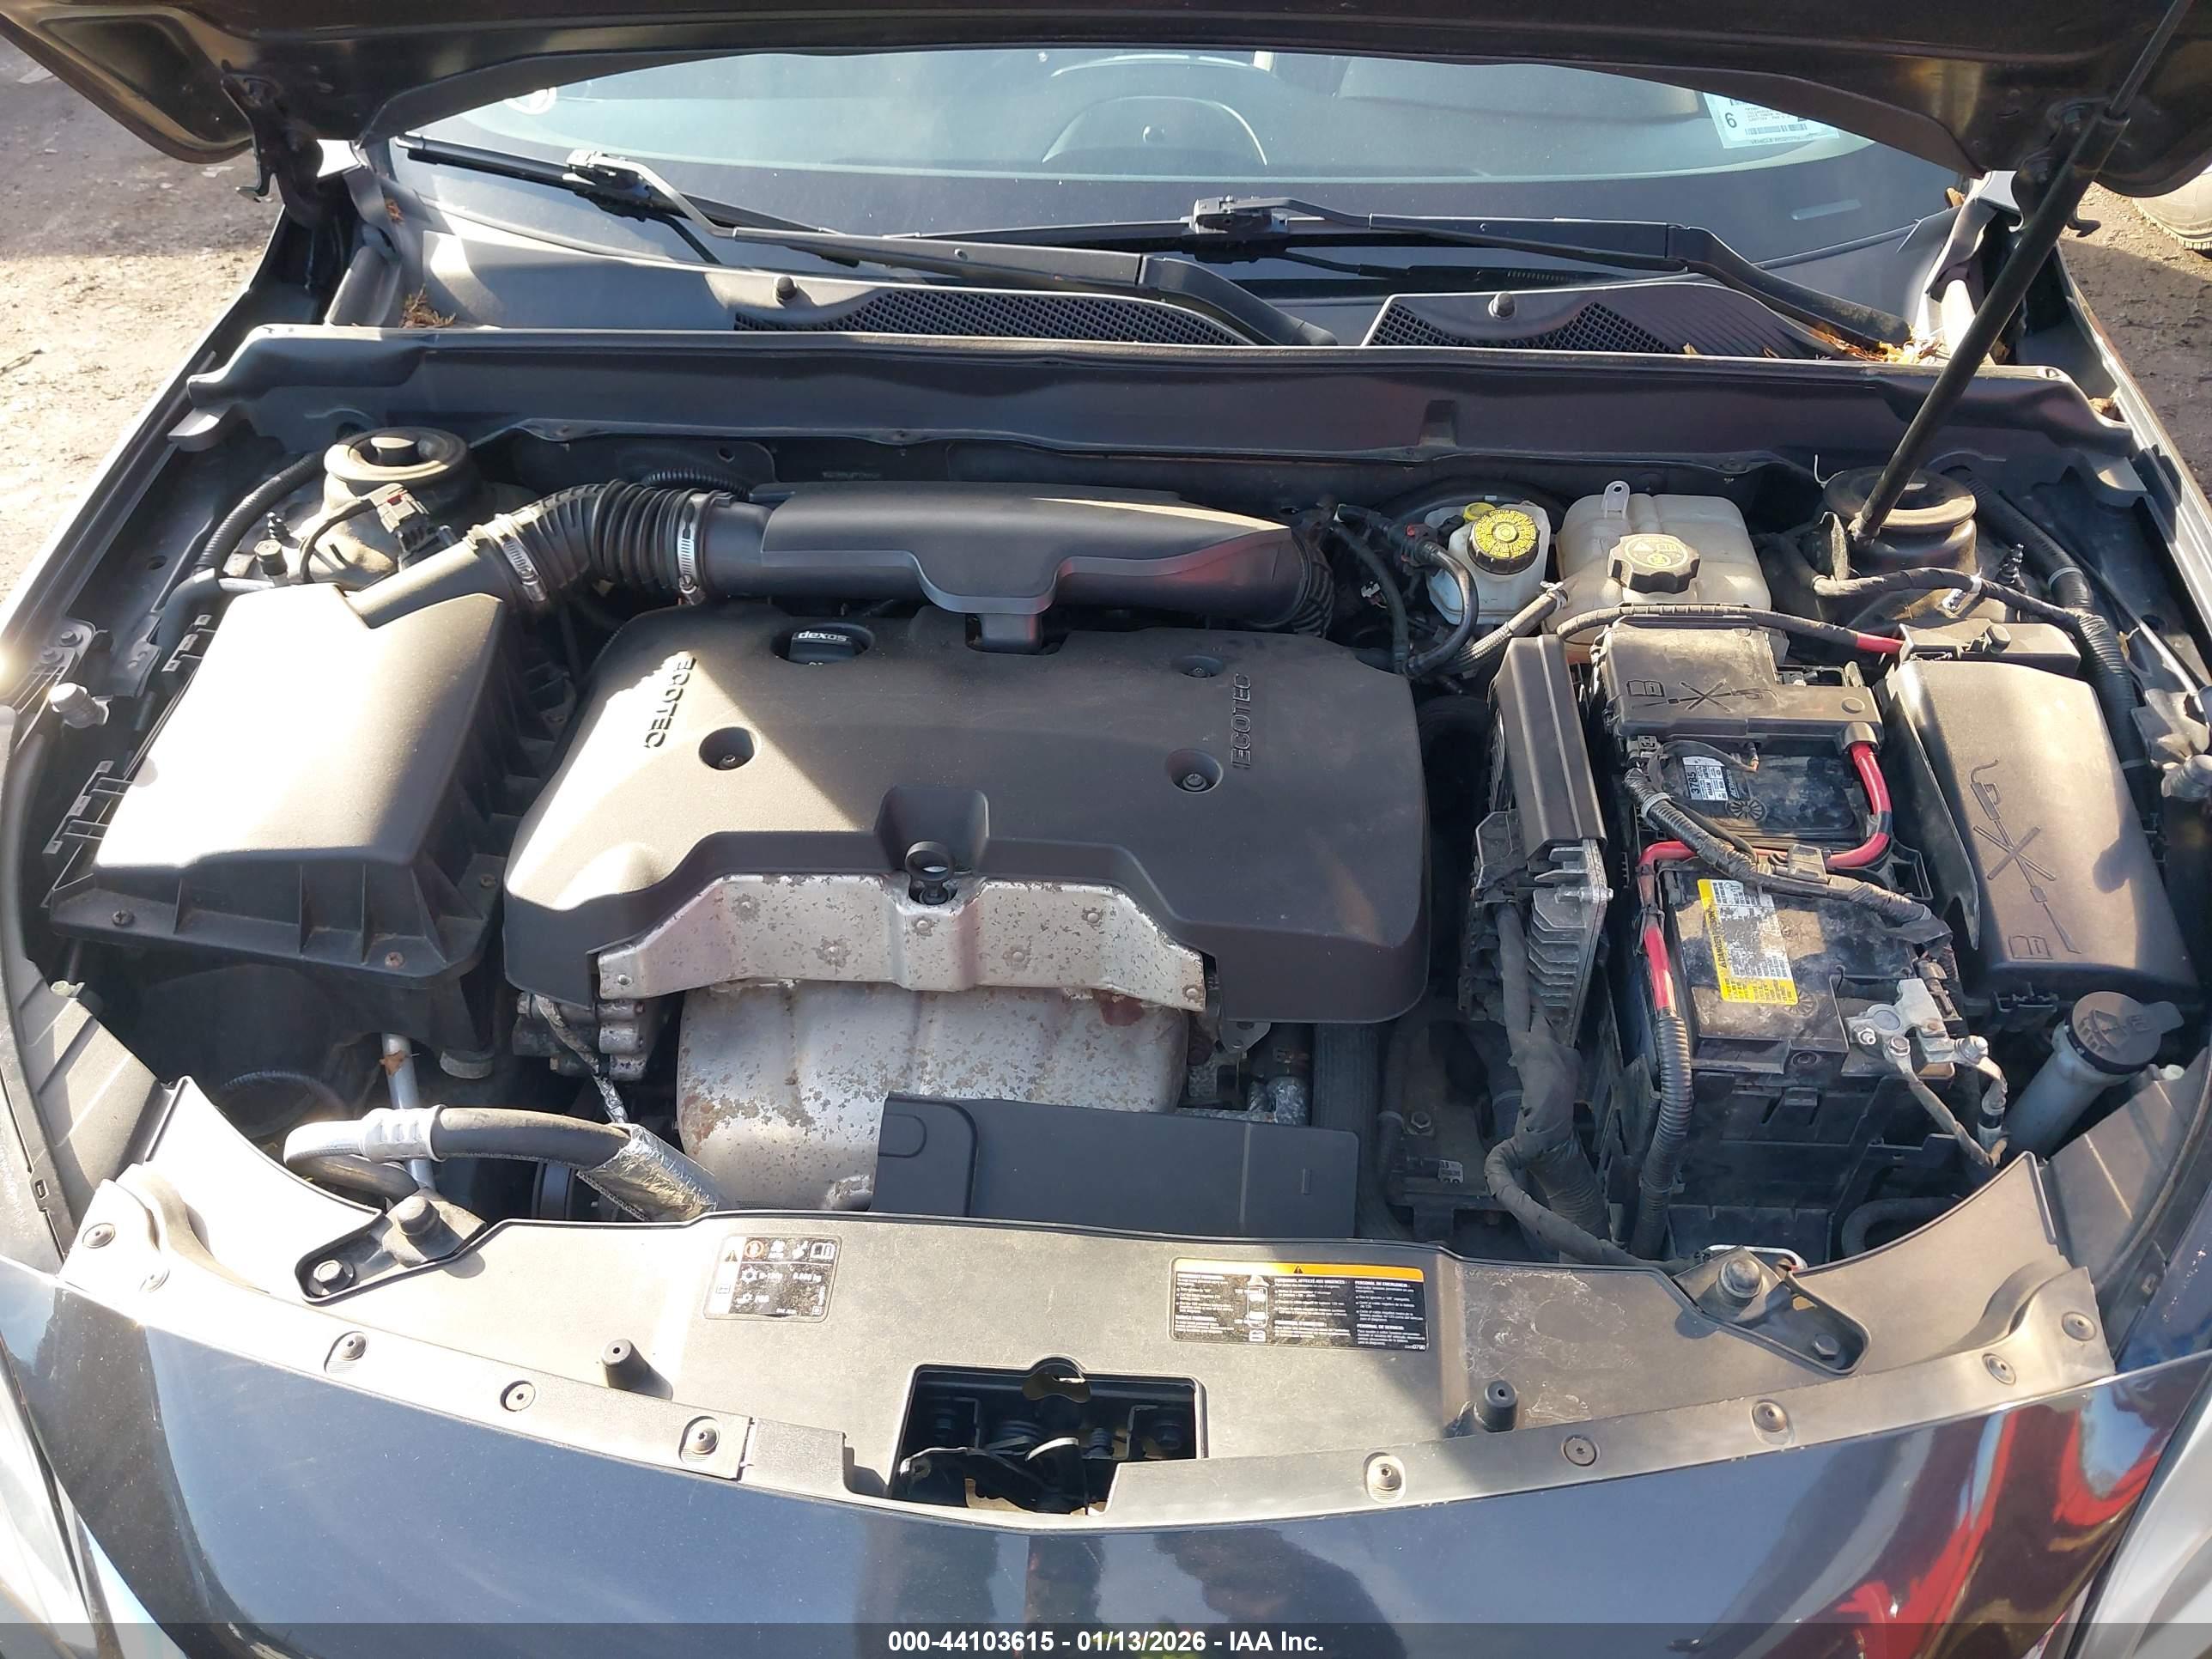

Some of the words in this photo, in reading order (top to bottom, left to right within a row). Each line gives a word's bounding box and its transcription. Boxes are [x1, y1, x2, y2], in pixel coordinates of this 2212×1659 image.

[1724, 112, 1737, 129] 6
[798, 630, 850, 641] dexos
[643, 656, 697, 749] ECOTEC
[1231, 673, 1251, 769] ECOTEC
[1687, 771, 1700, 794] 3785
[1713, 935, 1726, 962] DANGER
